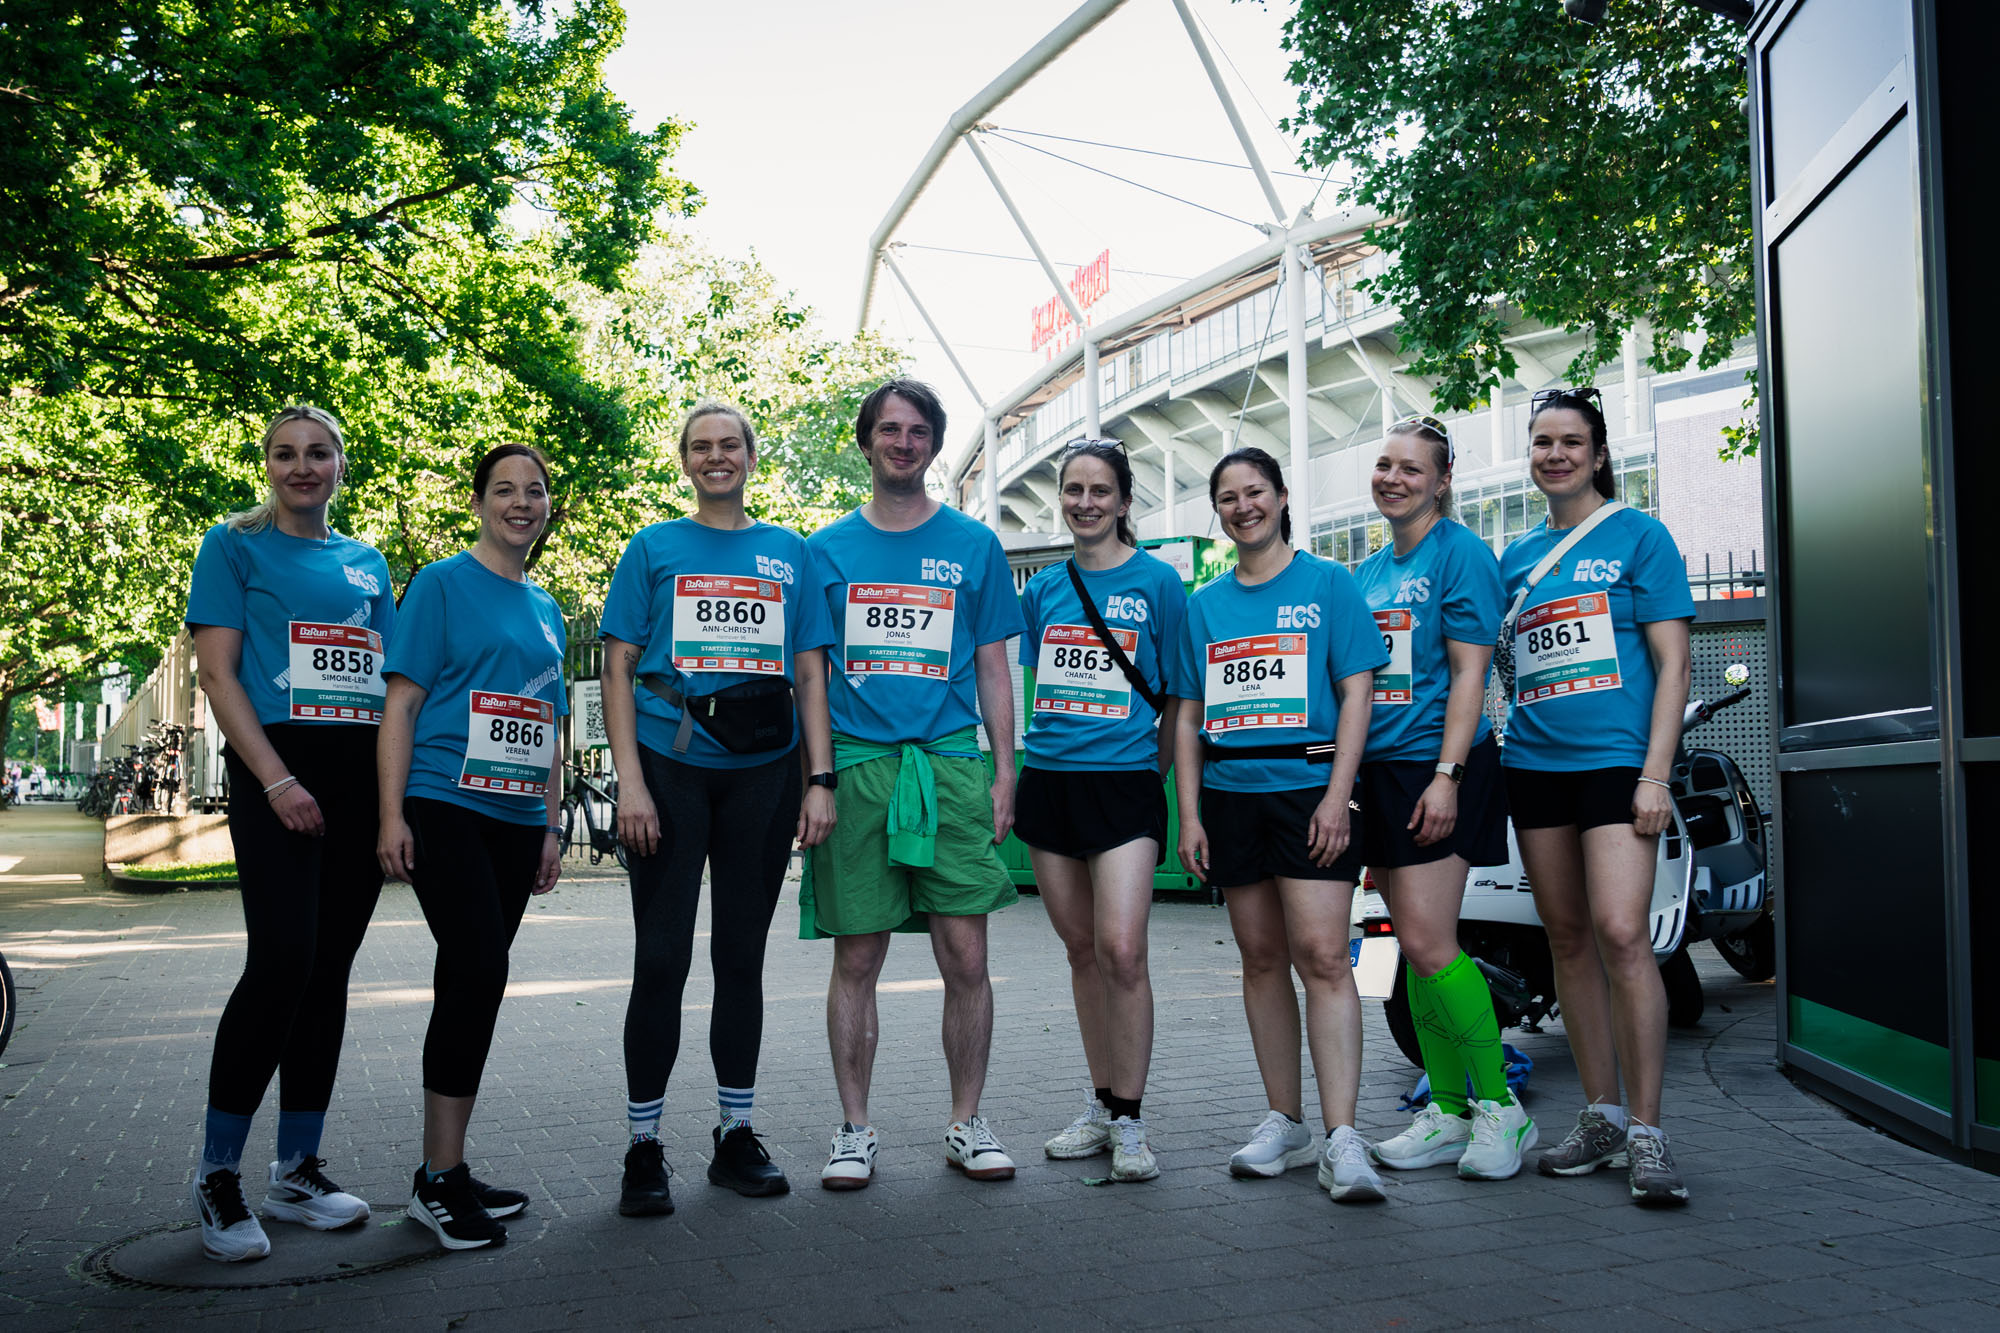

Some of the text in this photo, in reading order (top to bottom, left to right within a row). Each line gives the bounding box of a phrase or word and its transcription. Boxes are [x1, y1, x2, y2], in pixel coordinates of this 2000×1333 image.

[755, 555, 794, 585] HCS
[921, 558, 963, 584] HCS
[1572, 558, 1622, 583] HCS
[696, 600, 766, 625] 8860
[866, 607, 934, 631] 8857
[1105, 595, 1147, 622] HCS
[1276, 603, 1321, 629] HCS
[702, 625, 760, 634] ANN-CHRISTIN
[886, 631, 911, 639] JONAS
[1527, 621, 1591, 654] 8861
[312, 648, 374, 676] 8858
[1054, 647, 1114, 672] 8863
[1537, 647, 1581, 662] DOMINIQUE
[321, 674, 369, 685] SIMONE-LENI
[1064, 671, 1097, 680] CHANTAL
[1223, 658, 1286, 685] 8864
[1242, 683, 1261, 691] LENA
[490, 719, 543, 748] 8866
[505, 746, 530, 756] VERENA
